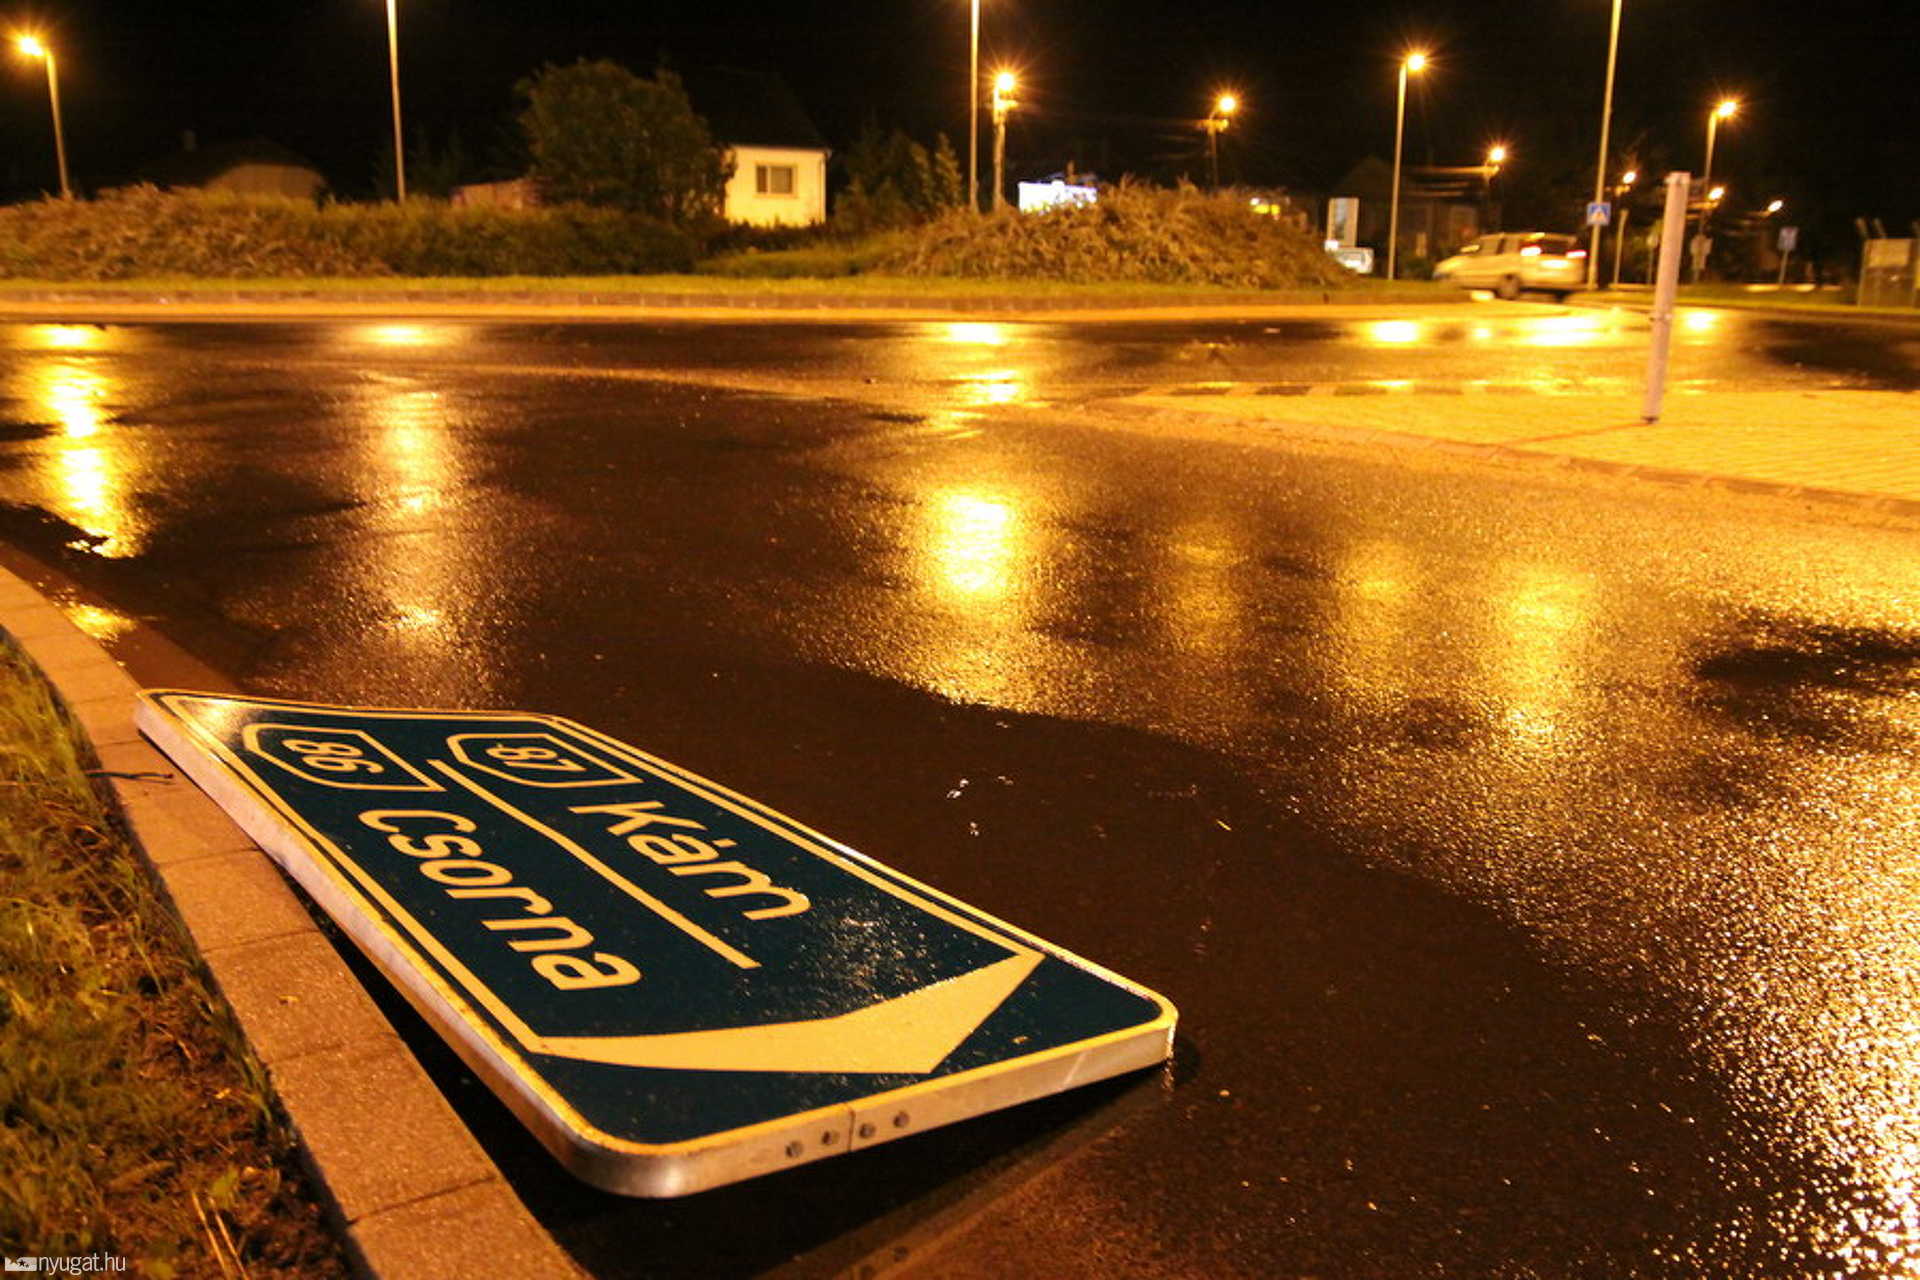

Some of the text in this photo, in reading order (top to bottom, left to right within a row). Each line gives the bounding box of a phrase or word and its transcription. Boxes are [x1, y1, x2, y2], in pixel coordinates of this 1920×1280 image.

[282, 739, 641, 990] 86 Csorna
[486, 742, 811, 920] 87 Kám
